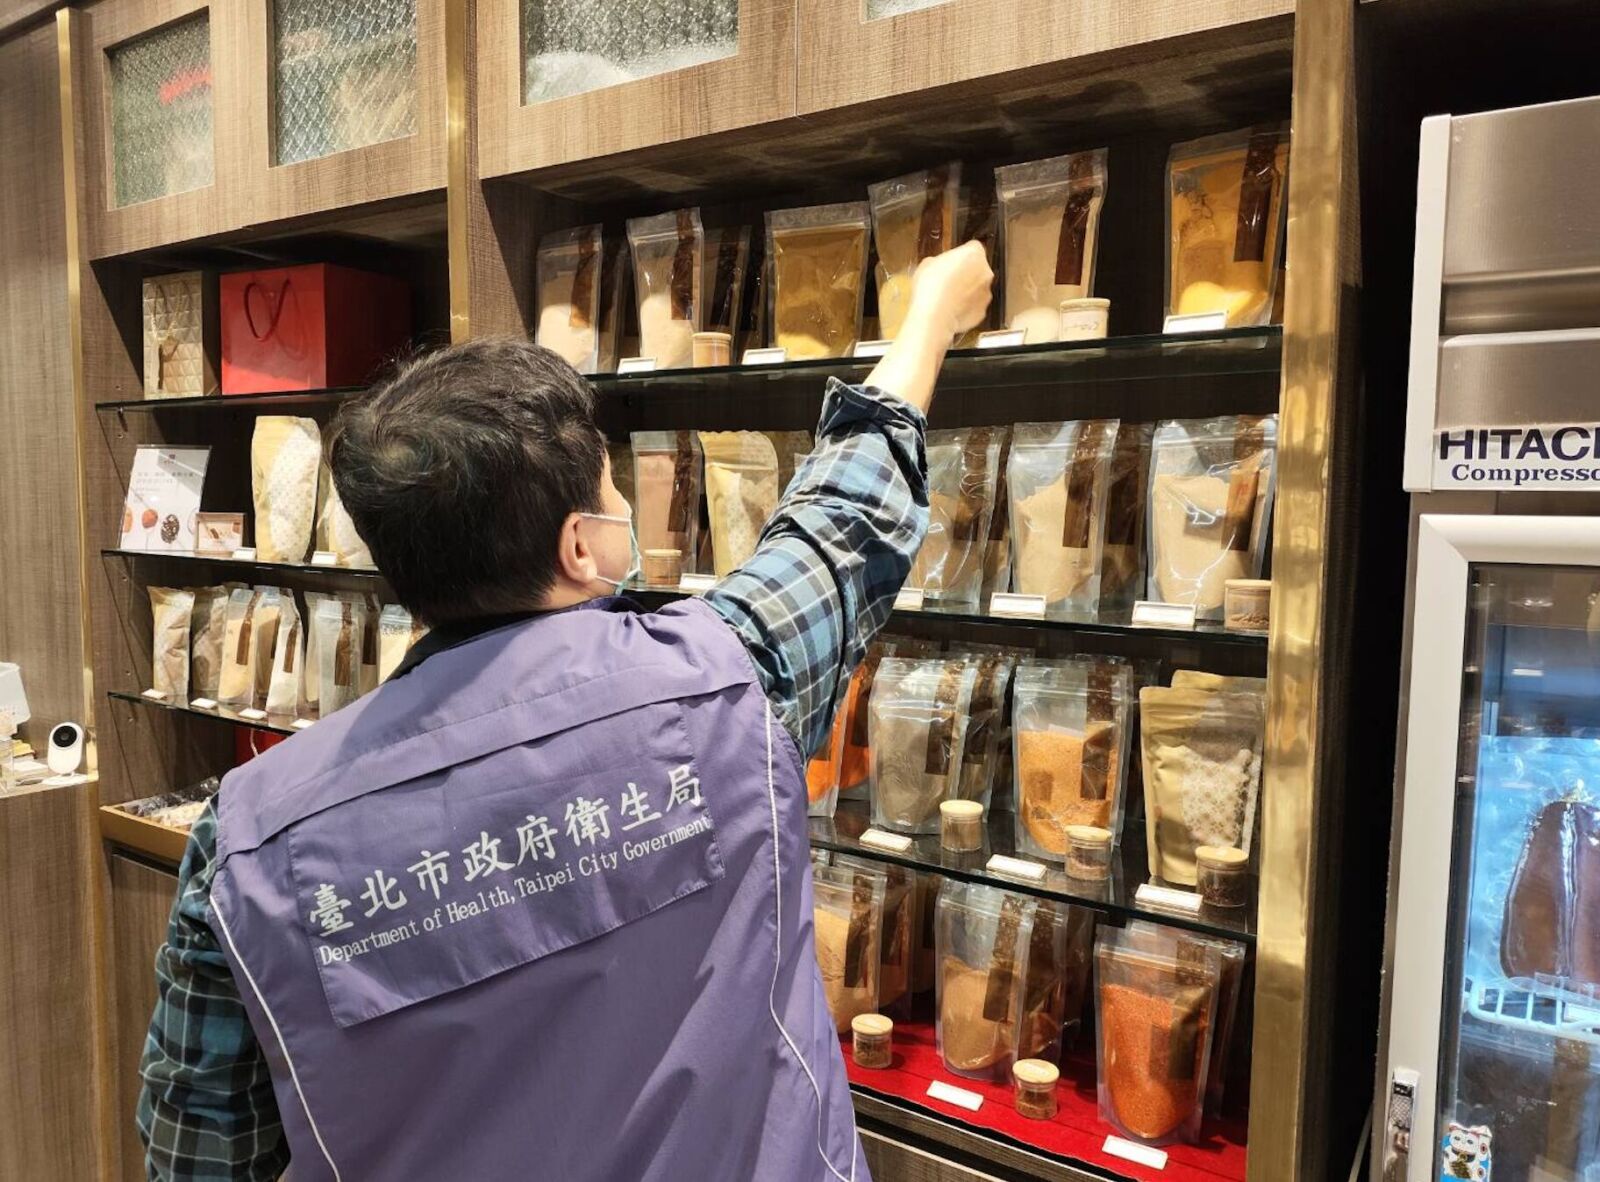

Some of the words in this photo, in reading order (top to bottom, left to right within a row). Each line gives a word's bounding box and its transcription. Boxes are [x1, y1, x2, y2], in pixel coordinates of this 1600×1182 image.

[309, 764, 705, 937] 臺北市政府衛生局
[319, 920, 420, 966] Department
[422, 908, 444, 932] of
[513, 862, 576, 899] Taipei
[578, 850, 618, 877] City
[622, 815, 712, 861] Government
